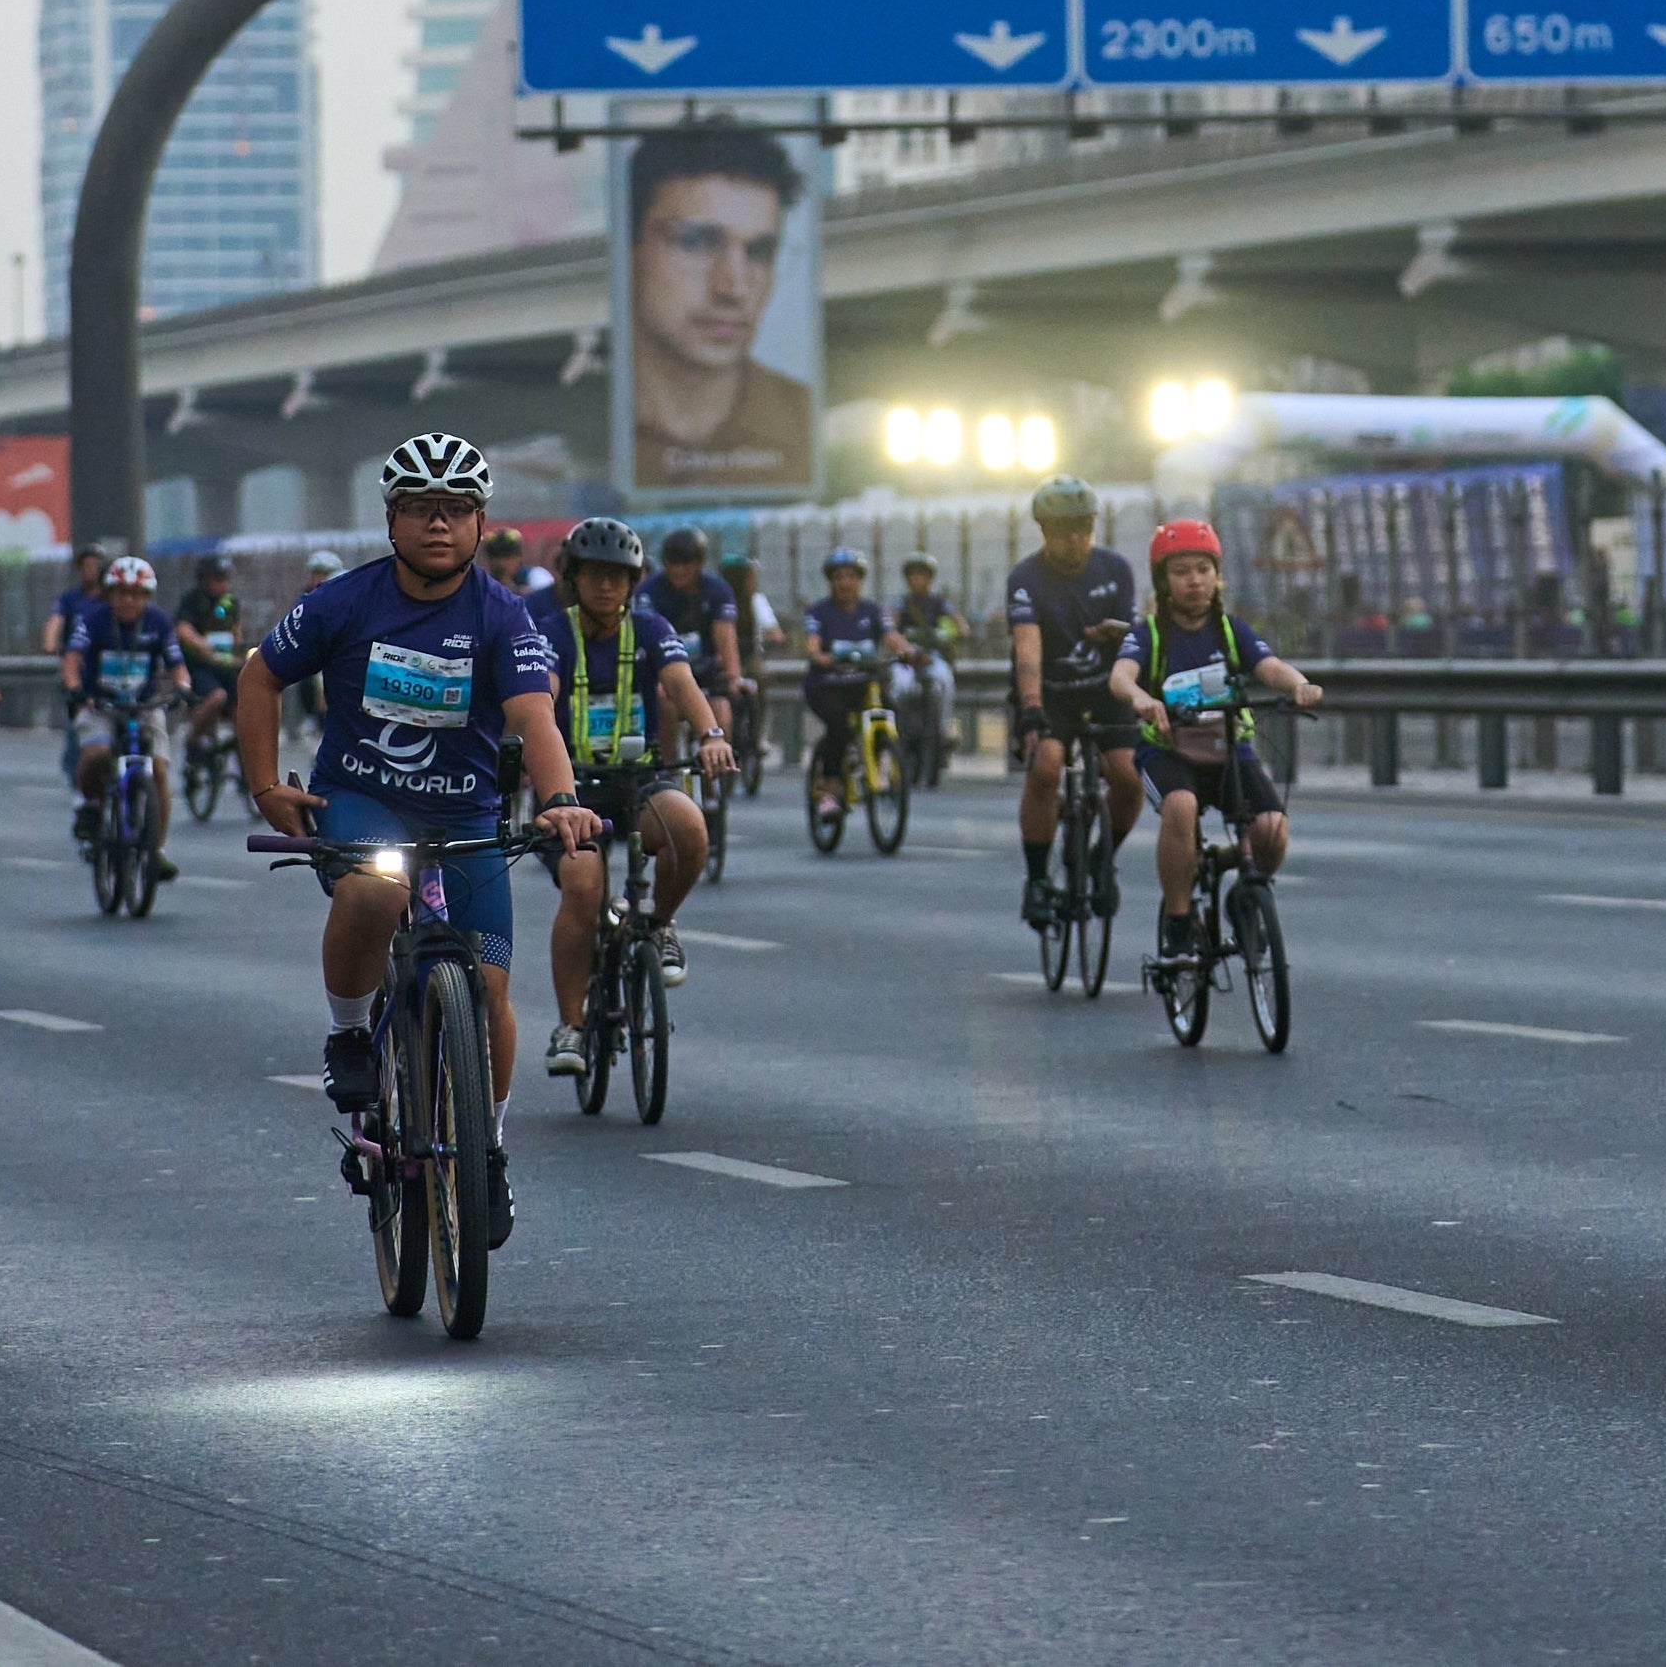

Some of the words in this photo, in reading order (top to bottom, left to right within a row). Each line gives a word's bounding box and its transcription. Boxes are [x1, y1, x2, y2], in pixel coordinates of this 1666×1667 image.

[1101, 18, 1256, 60] 2300m
[1485, 13, 1614, 55] 650m
[383, 652, 407, 664] RIDE
[442, 638, 472, 649] RIDE
[380, 677, 434, 701] 19390
[342, 753, 375, 776] DP
[380, 770, 476, 794] WORLD
